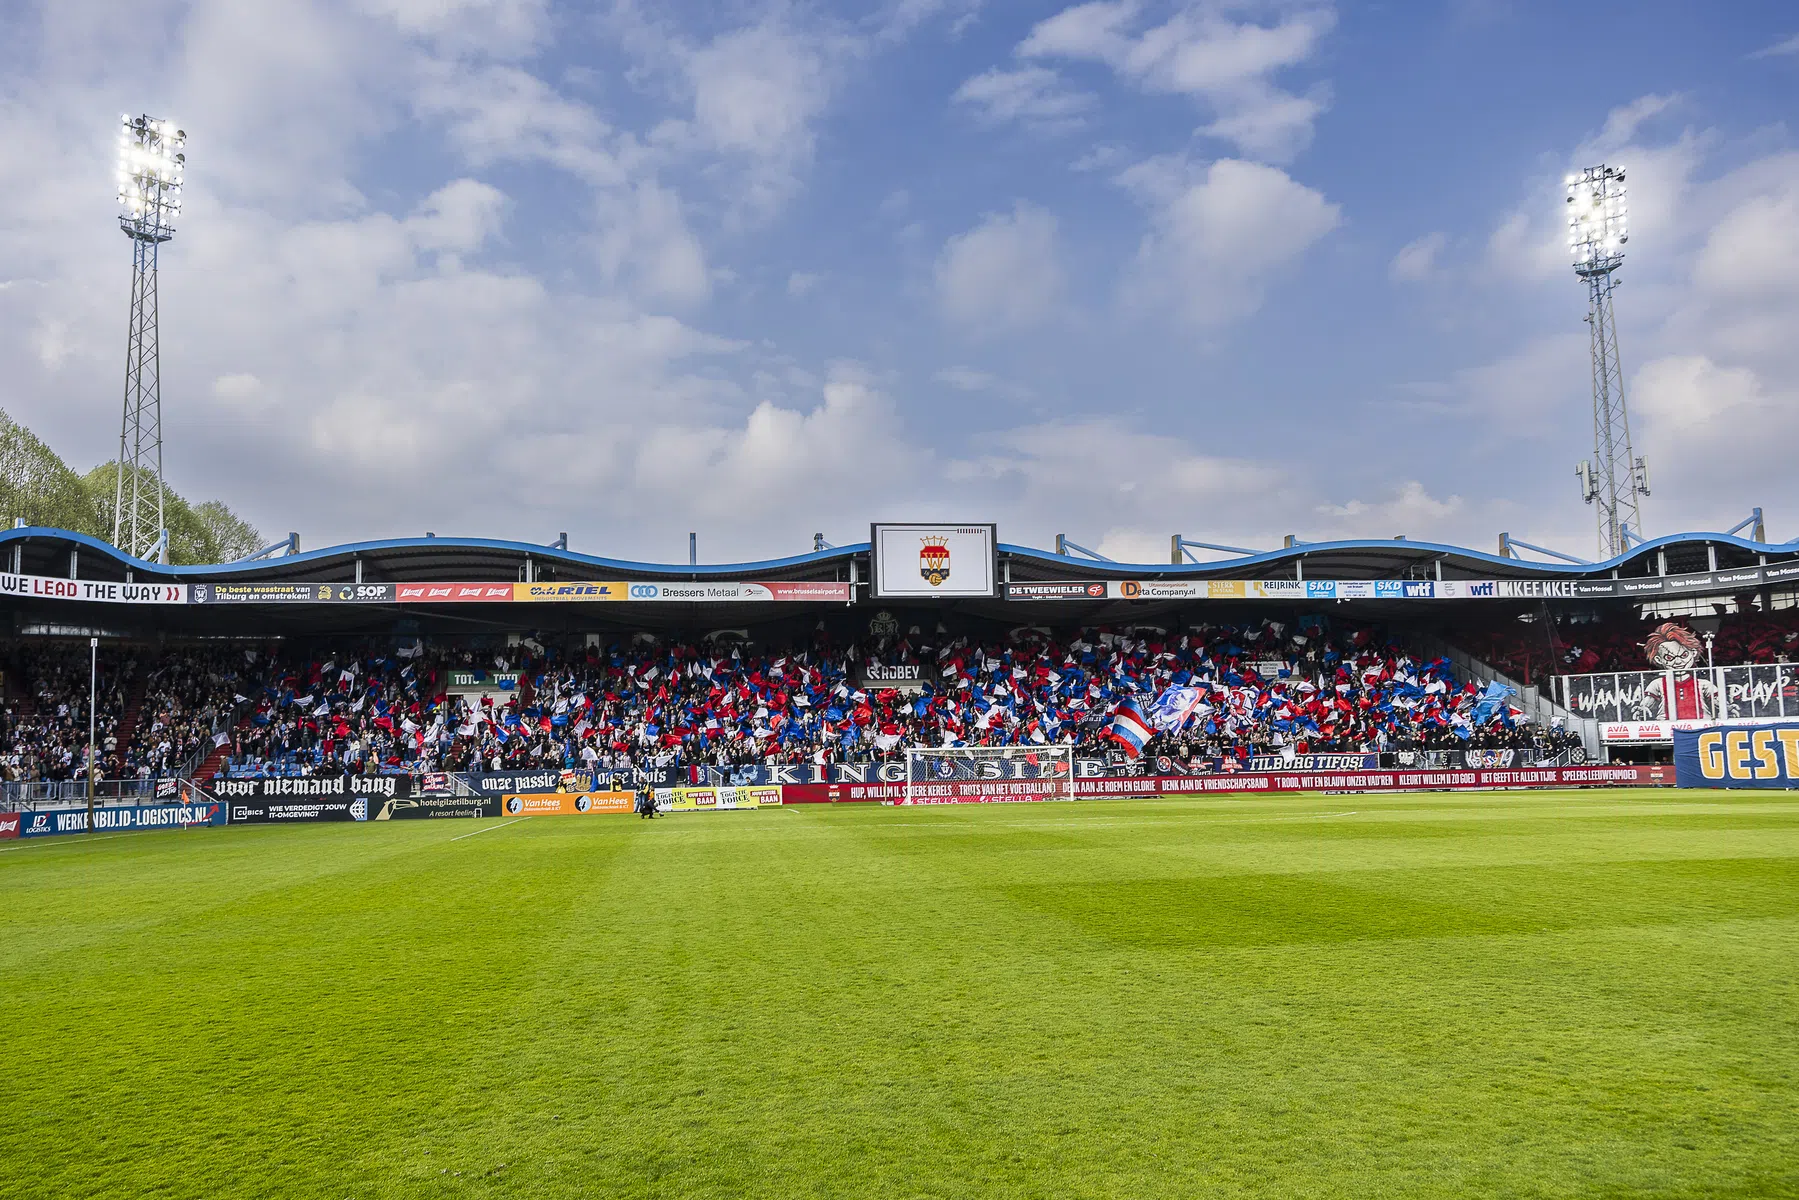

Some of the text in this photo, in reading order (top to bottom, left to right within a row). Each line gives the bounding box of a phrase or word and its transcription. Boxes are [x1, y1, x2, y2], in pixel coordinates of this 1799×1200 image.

[1685, 578, 1712, 586] Mossel
[1733, 572, 1759, 581] Mossel
[1, 575, 161, 601] WE LEAD THE WAY
[356, 585, 387, 597] SOP
[557, 586, 612, 595] RIEL
[1009, 586, 1085, 594] DE TWEEWIELER
[1263, 581, 1301, 590] REIJRINK
[1308, 581, 1335, 591] SKD
[1376, 581, 1402, 591] SKD
[1406, 583, 1431, 597] wtf
[1470, 583, 1493, 596] wtf
[1640, 582, 1662, 590] Mossel
[215, 593, 247, 601] Tilburg
[261, 592, 310, 600] omstreken!
[662, 587, 739, 597] Bressers Metaal
[777, 588, 845, 596] www.brusselsairport.nl
[1151, 587, 1196, 597] Company.nl
[881, 665, 920, 679] ROBEY
[1577, 684, 1643, 713] WANNA
[1697, 728, 1799, 779] GEST
[1316, 756, 1364, 769] TIFOSI
[765, 763, 908, 785] KING
[1399, 774, 1422, 786] KLEURT
[1422, 773, 1446, 785] WILLEM
[1451, 773, 1459, 784] ZO
[1460, 773, 1476, 784] GOED
[1480, 770, 1557, 783] HET GEEFT TE ALLEN TIJDE
[1562, 769, 1637, 781] SPELERS LEEUWENMOED
[213, 780, 260, 796] voor
[263, 774, 345, 796] niemand
[481, 772, 557, 793] onze passie
[1080, 781, 1095, 793] AAN
[1096, 781, 1104, 792] JE
[1104, 781, 1123, 792] ROEM
[1123, 780, 1133, 792] EN
[1133, 780, 1156, 792] GLORIE
[1161, 777, 1269, 791] DENK AAN DE VRIENDSCHAPSBAND
[1281, 777, 1301, 789] ROOD,
[1301, 776, 1314, 788] WIT
[1314, 776, 1323, 788] EN
[1323, 776, 1346, 787] BLAUW
[1346, 775, 1367, 787] ONZER
[850, 786, 866, 799] HUP,
[927, 784, 953, 797] KERELS
[959, 784, 981, 796] TROTS
[981, 783, 996, 795] VAN
[995, 783, 1008, 795] HET
[420, 797, 492, 808] hotelgilzetilburg.nl
[524, 798, 561, 807] Van Hees
[592, 797, 628, 806] Van Hees
[696, 796, 715, 805] BAAN
[760, 795, 779, 804] BAAN
[56, 806, 210, 832] WERKENBIJ.ID-LOGISTICS.NL
[268, 811, 319, 819] IT-OMGEVING?
[33, 815, 47, 828] ID
[26, 826, 51, 834] LOGISTICS
